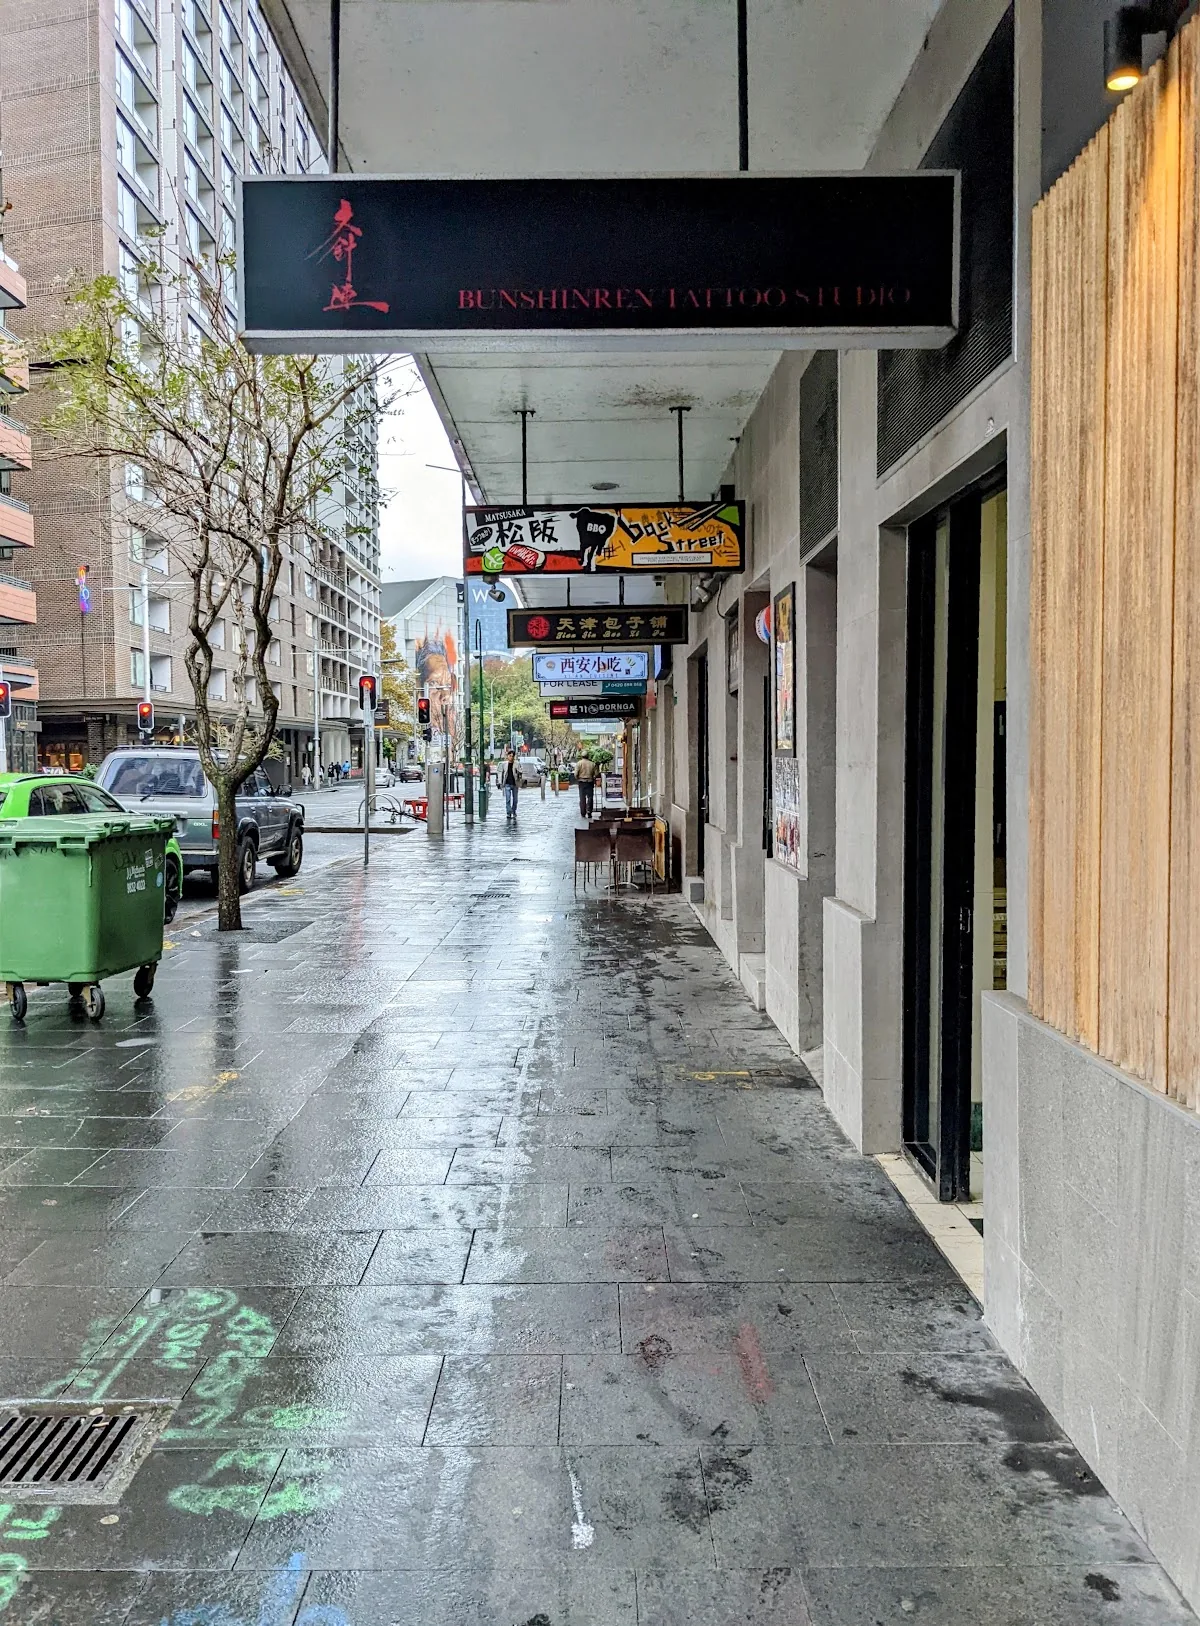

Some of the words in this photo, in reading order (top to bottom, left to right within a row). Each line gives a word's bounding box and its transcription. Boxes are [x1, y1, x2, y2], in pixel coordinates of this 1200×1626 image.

[458, 288, 656, 311] BUNSHINREN
[664, 286, 788, 312] TATTOO
[484, 508, 527, 523] MATSUSAKA
[496, 518, 559, 547] 松阪
[586, 522, 607, 535] BBQ
[617, 511, 677, 544] back
[656, 531, 726, 552] Street
[472, 588, 489, 603] W
[561, 656, 622, 674] 西安小吃
[569, 704, 588, 714] 본가
[599, 703, 635, 711] BORNGA
